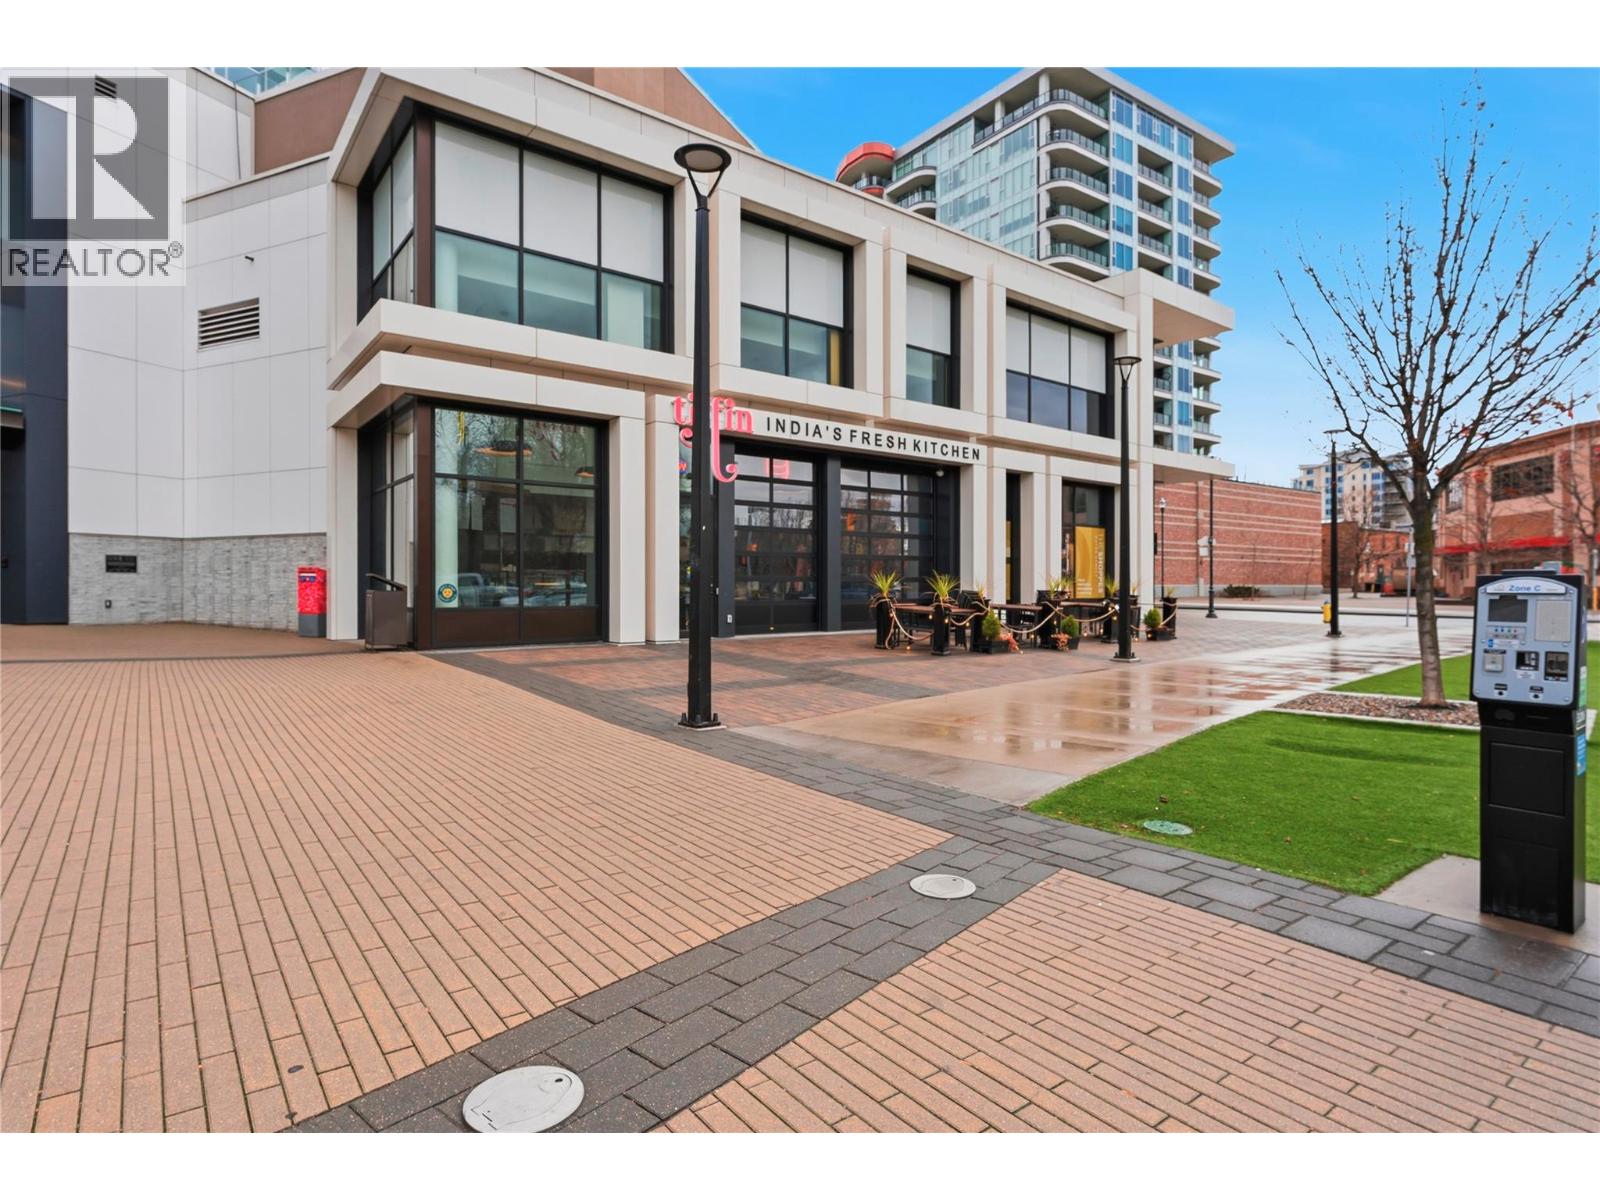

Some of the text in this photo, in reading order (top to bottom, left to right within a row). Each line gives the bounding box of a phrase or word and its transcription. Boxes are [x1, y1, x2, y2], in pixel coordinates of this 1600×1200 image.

[672, 391, 753, 483] tifin
[767, 417, 980, 461] INDIA'S FRESH KITCHEN
